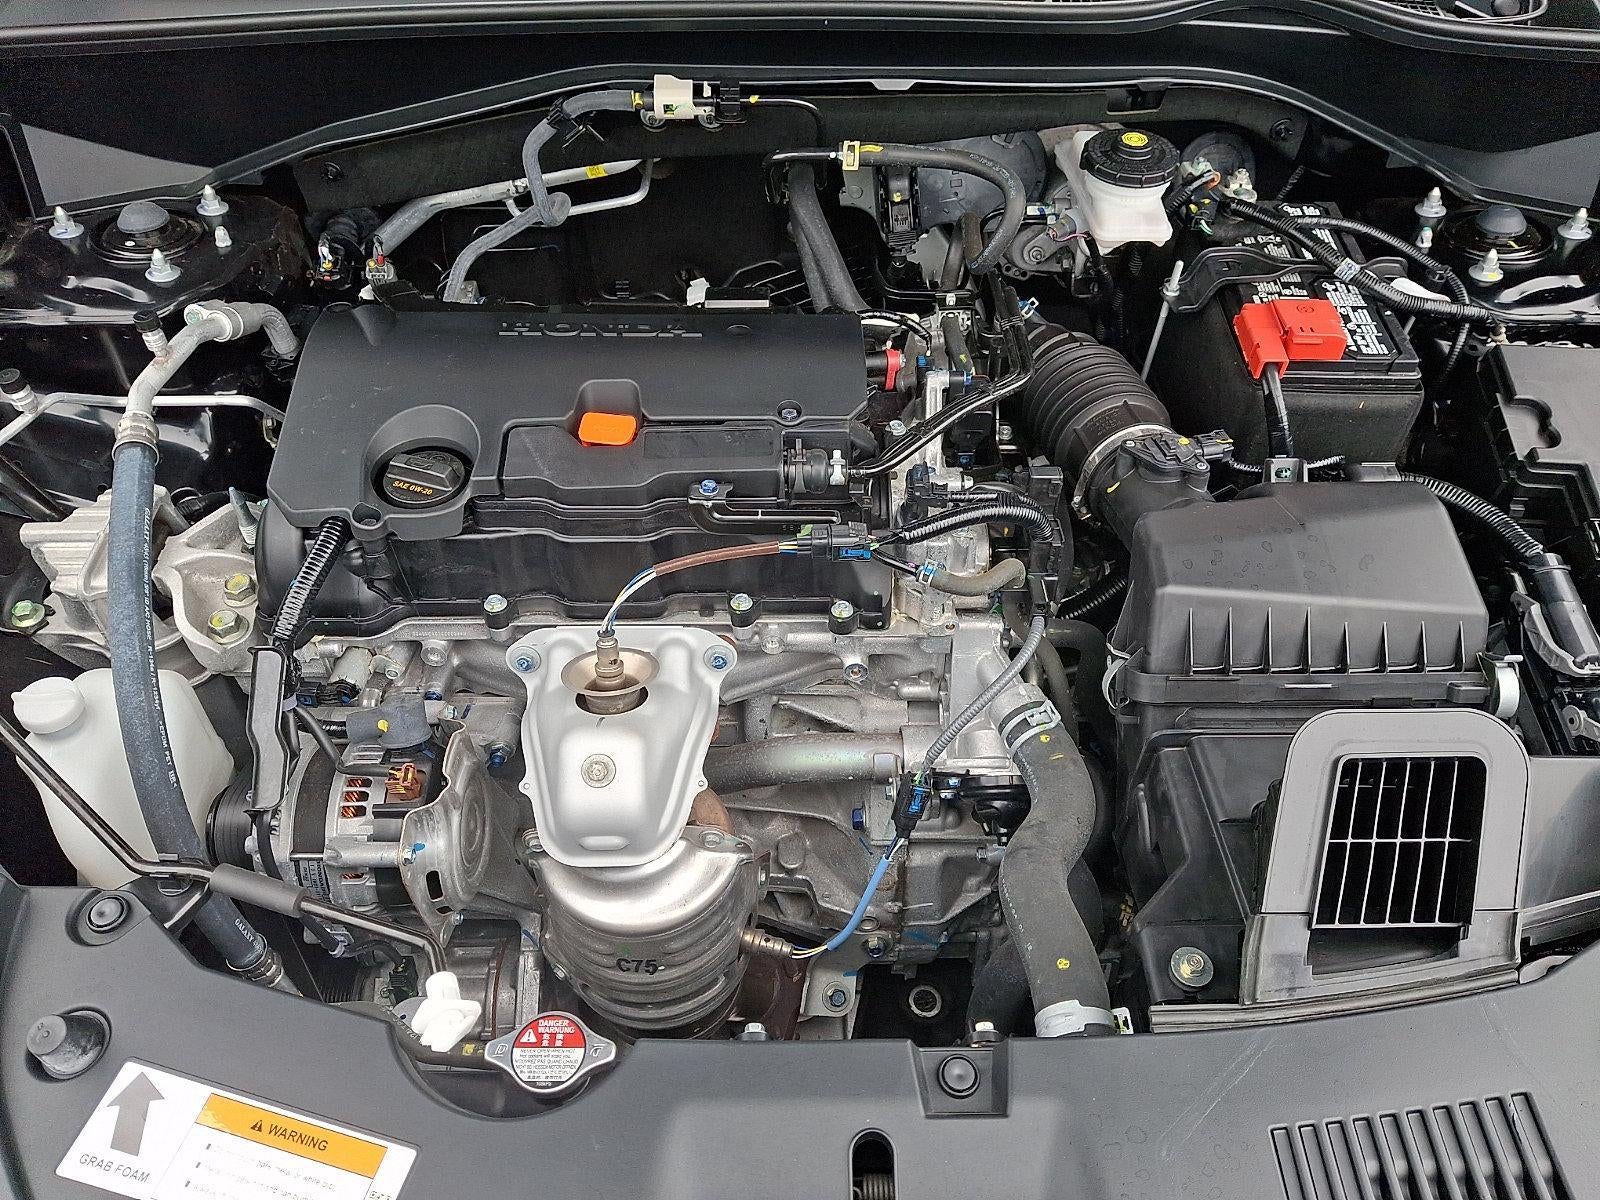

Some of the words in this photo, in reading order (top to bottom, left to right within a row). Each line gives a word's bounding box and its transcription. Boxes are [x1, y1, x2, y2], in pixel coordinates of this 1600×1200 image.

[498, 322, 703, 337] HONDA
[392, 480, 408, 490] SAE
[409, 484, 433, 495] 0W-20
[234, 918, 255, 942] GALAXY
[616, 958, 659, 976] C75
[537, 1026, 576, 1034] WARNUNG
[538, 1019, 569, 1027] DANGER
[268, 1123, 329, 1151] WARNING
[79, 1153, 113, 1172] GRAB
[115, 1164, 151, 1183] FOAM
